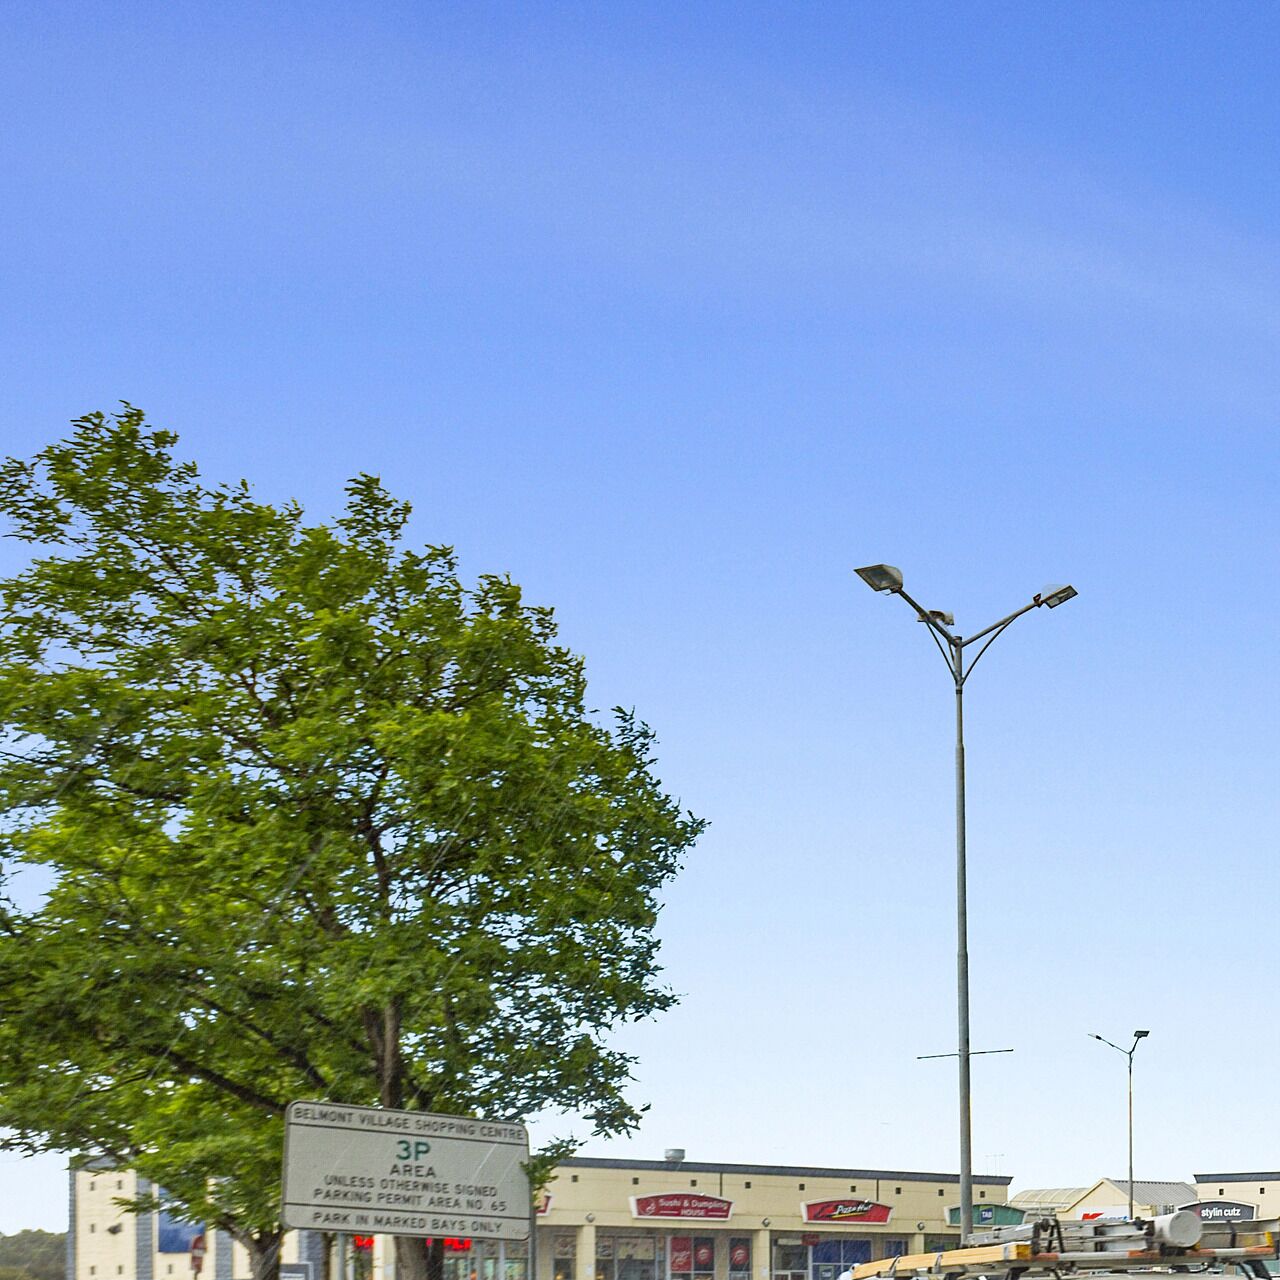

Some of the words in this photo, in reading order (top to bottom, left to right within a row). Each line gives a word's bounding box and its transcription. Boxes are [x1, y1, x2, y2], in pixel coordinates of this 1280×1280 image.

[293, 1107, 353, 1123] BELMONT
[360, 1113, 409, 1129] VILLAGE
[415, 1119, 476, 1137] SHOPPING
[479, 1126, 524, 1141] CENTRE
[395, 1140, 432, 1161] 3P
[389, 1163, 436, 1178] AREA
[324, 1174, 375, 1188] UNLESS
[380, 1178, 450, 1194] OTHERWISE
[454, 1184, 498, 1198] SIGNED
[313, 1187, 372, 1203] PARKING
[377, 1192, 422, 1206] PERMIT
[427, 1196, 463, 1209] AREA
[312, 1212, 350, 1225] PARK
[355, 1213, 369, 1226] IN
[373, 1215, 427, 1230] MARKED
[430, 1218, 466, 1232] BAYS
[470, 1220, 503, 1234] ONLY
[1201, 1207, 1223, 1217] stylin
[1223, 1207, 1241, 1217] cutz
